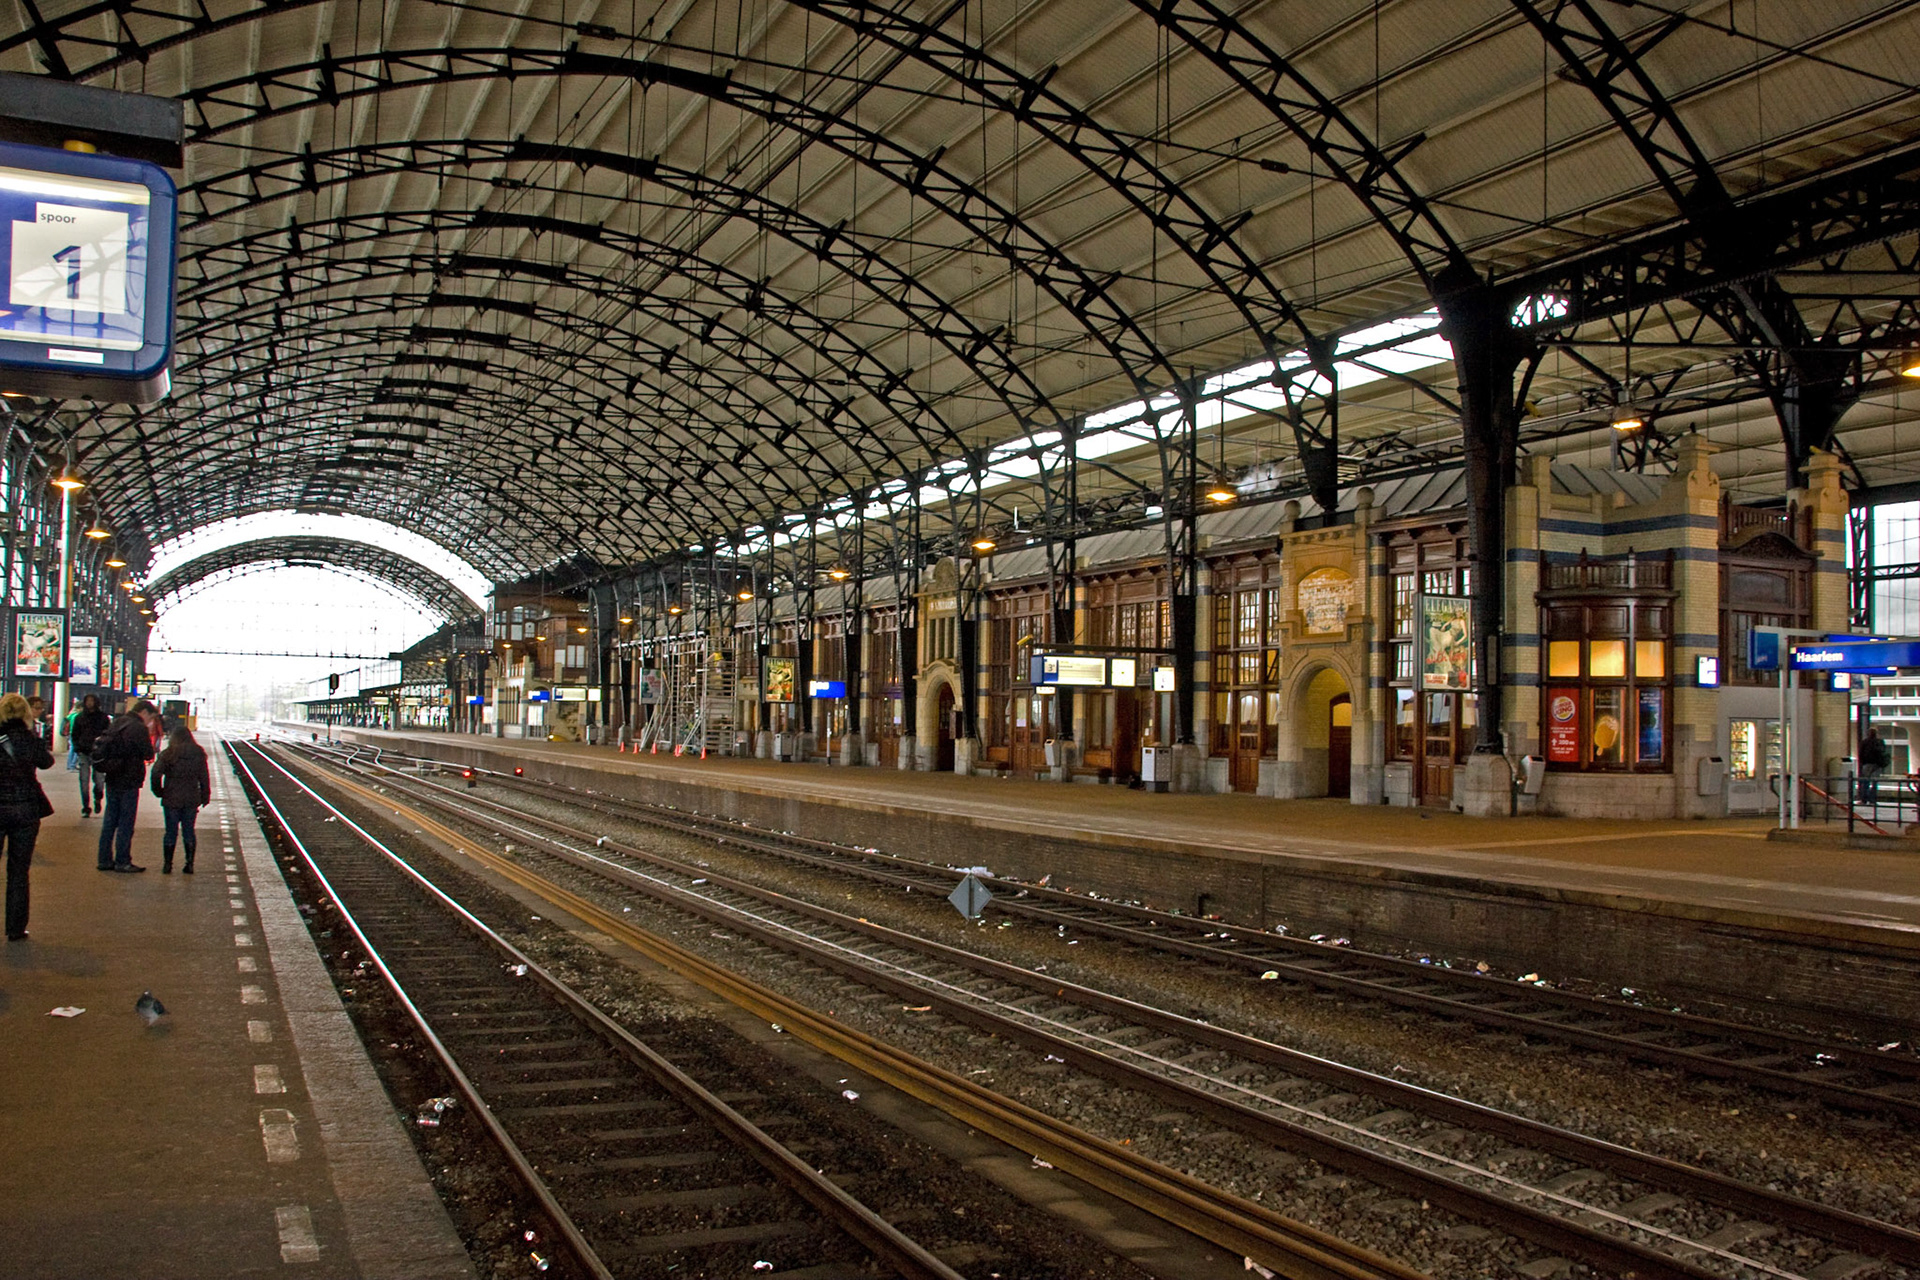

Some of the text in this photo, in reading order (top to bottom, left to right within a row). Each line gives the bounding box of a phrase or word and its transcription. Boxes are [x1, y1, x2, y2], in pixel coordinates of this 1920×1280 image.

[40, 212, 76, 224] spoor
[52, 245, 81, 299] 1
[1796, 650, 1844, 663] Haarlem
